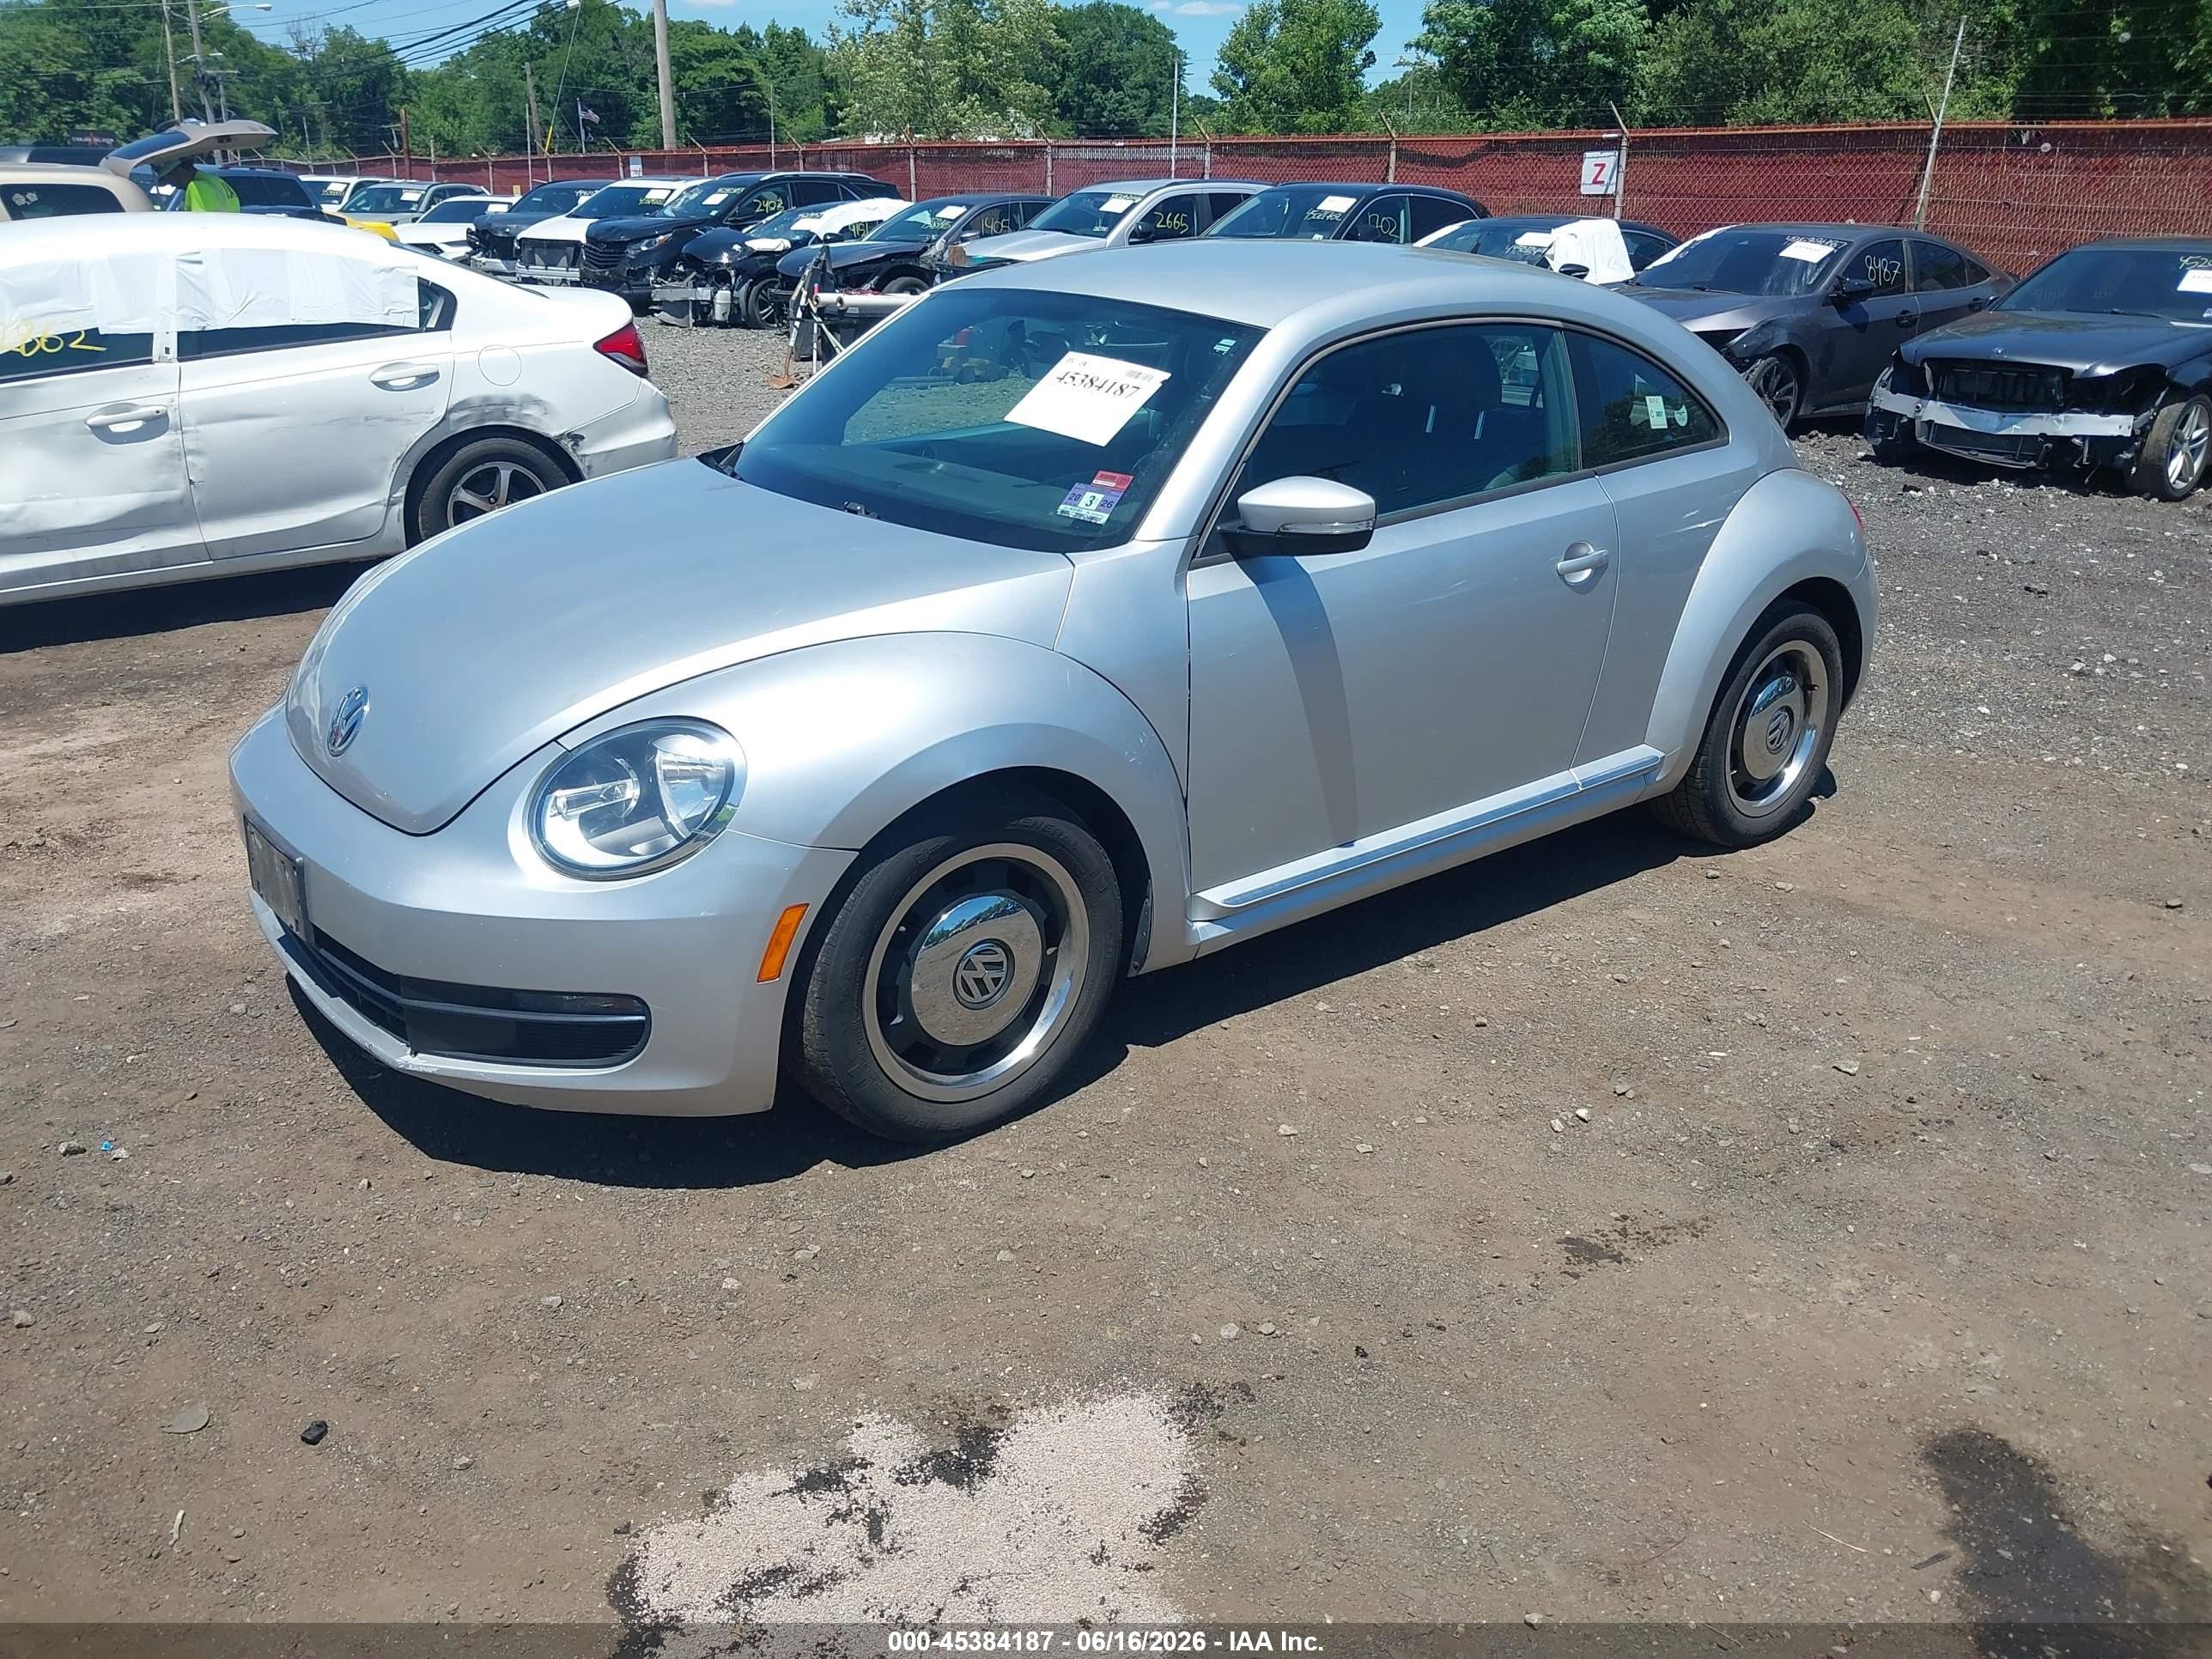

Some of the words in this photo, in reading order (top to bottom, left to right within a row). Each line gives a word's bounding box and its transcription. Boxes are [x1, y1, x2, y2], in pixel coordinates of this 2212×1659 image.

[1591, 162, 1607, 185] Z
[752, 197, 785, 214] 2403
[981, 216, 1012, 236] 1405
[1153, 211, 1189, 234] 2665
[1864, 254, 1902, 286] 8487
[1055, 370, 1141, 399] 45384187
[1067, 492, 1082, 501] 20
[1085, 495, 1096, 507] 3
[1100, 500, 1115, 509] 26
